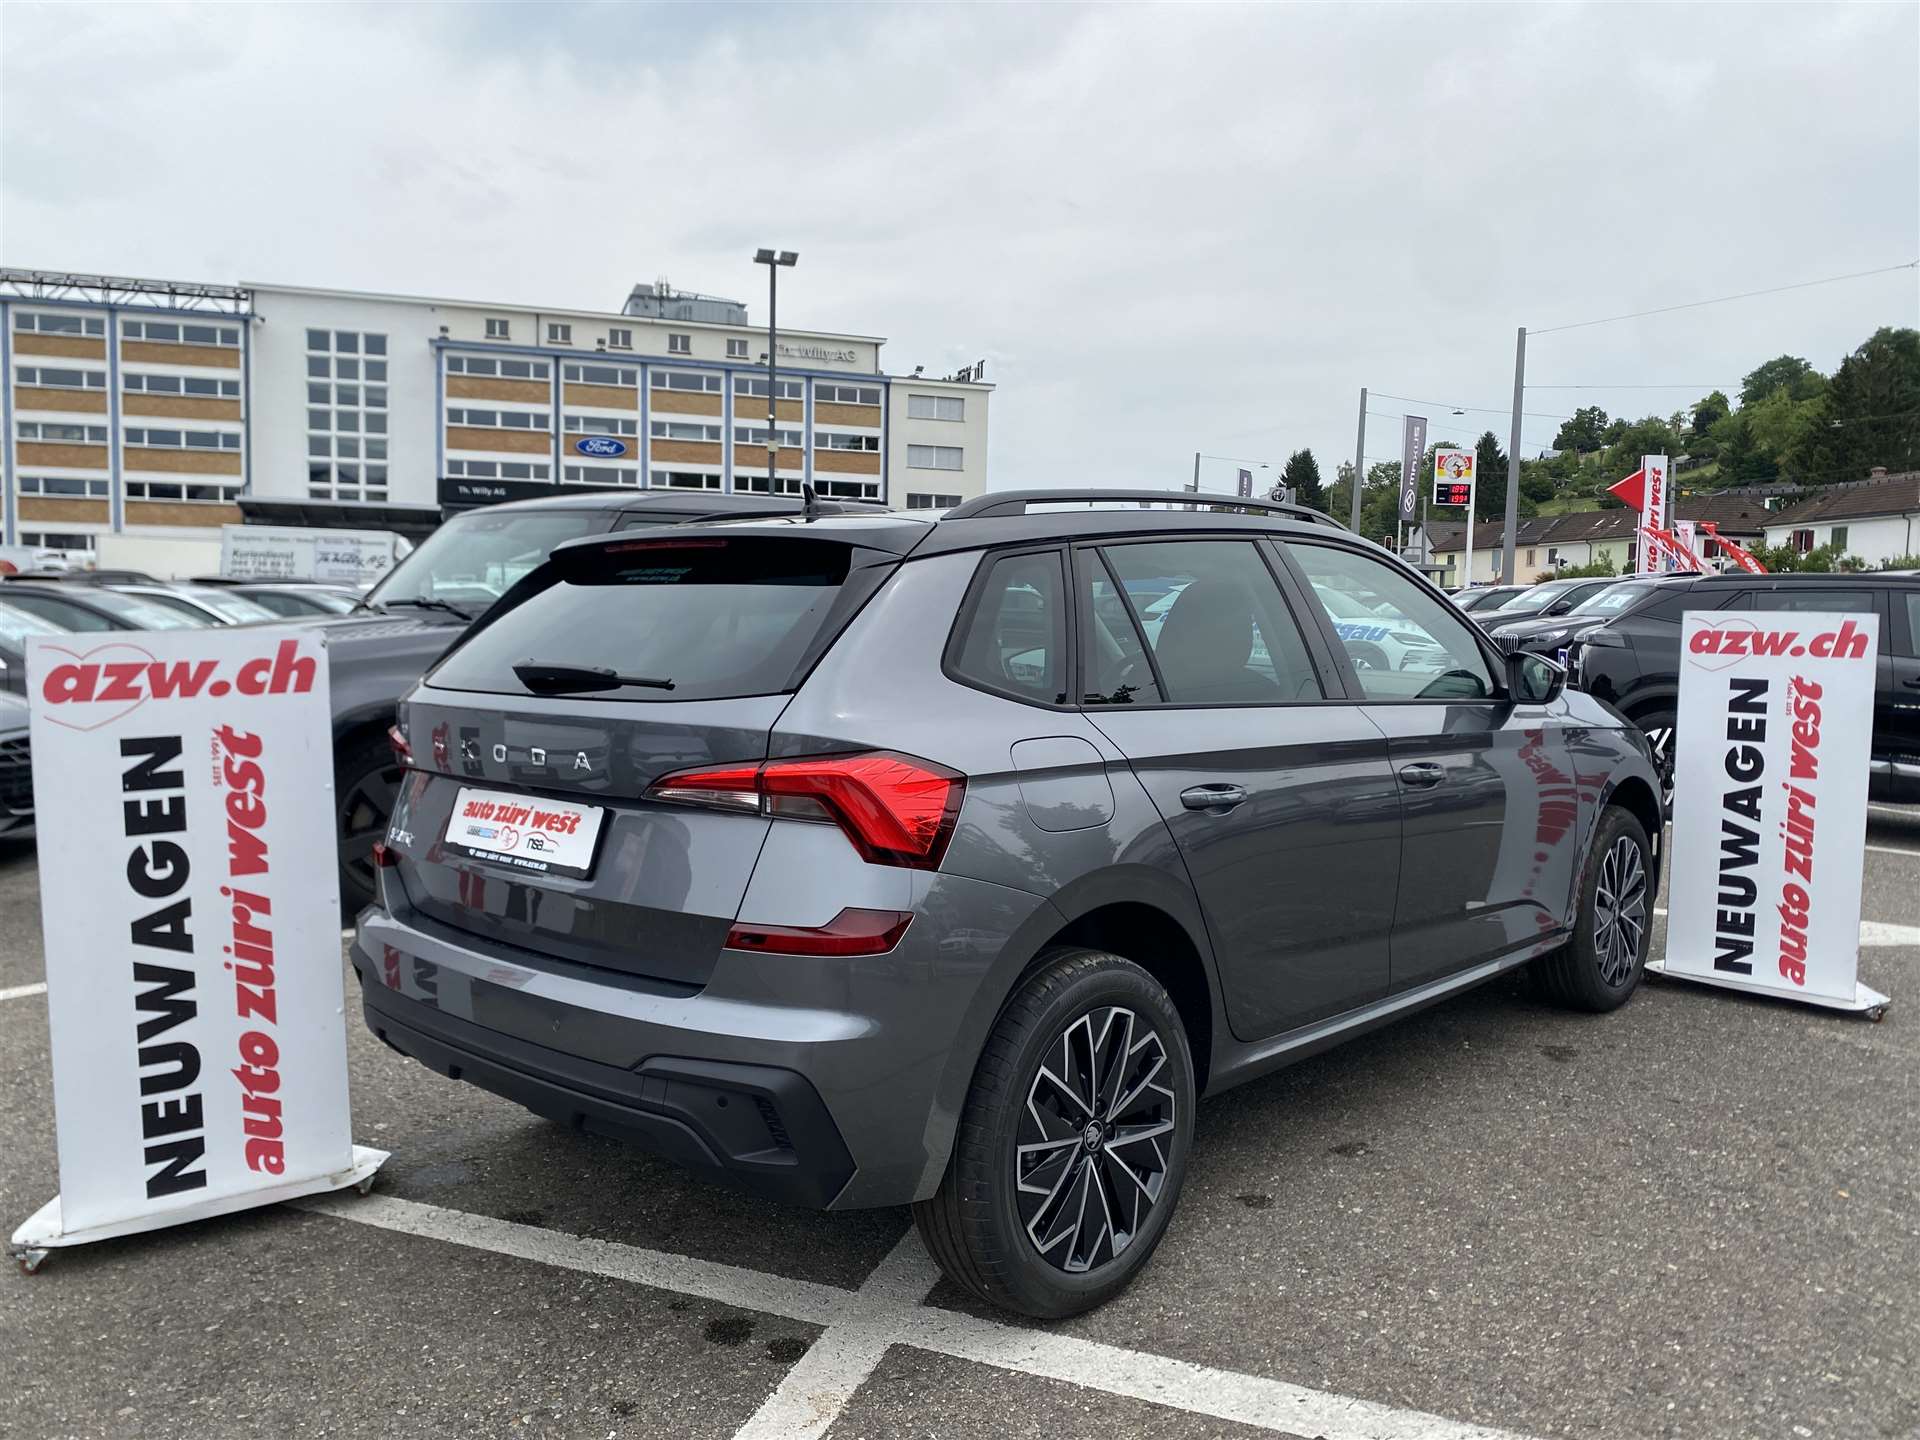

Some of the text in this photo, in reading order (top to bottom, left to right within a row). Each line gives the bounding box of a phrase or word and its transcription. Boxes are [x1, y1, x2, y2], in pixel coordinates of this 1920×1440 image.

[799, 344, 830, 363] Willy
[585, 439, 618, 454] Ford
[1409, 426, 1420, 486] MAXUS
[472, 487, 492, 497] Willy
[493, 487, 506, 496] AG
[1650, 467, 1662, 506] west
[1689, 620, 1869, 659] azw.ch
[43, 640, 317, 704] azw.ch
[212, 766, 222, 787] SEIT
[463, 799, 581, 835] auto züri west
[1714, 678, 1769, 975] NEUWAGEN
[1775, 675, 1823, 987] auto züri west
[526, 836, 544, 850] nsa
[120, 736, 207, 1199] NEUWAGEN
[211, 724, 286, 1176] auto züri west
